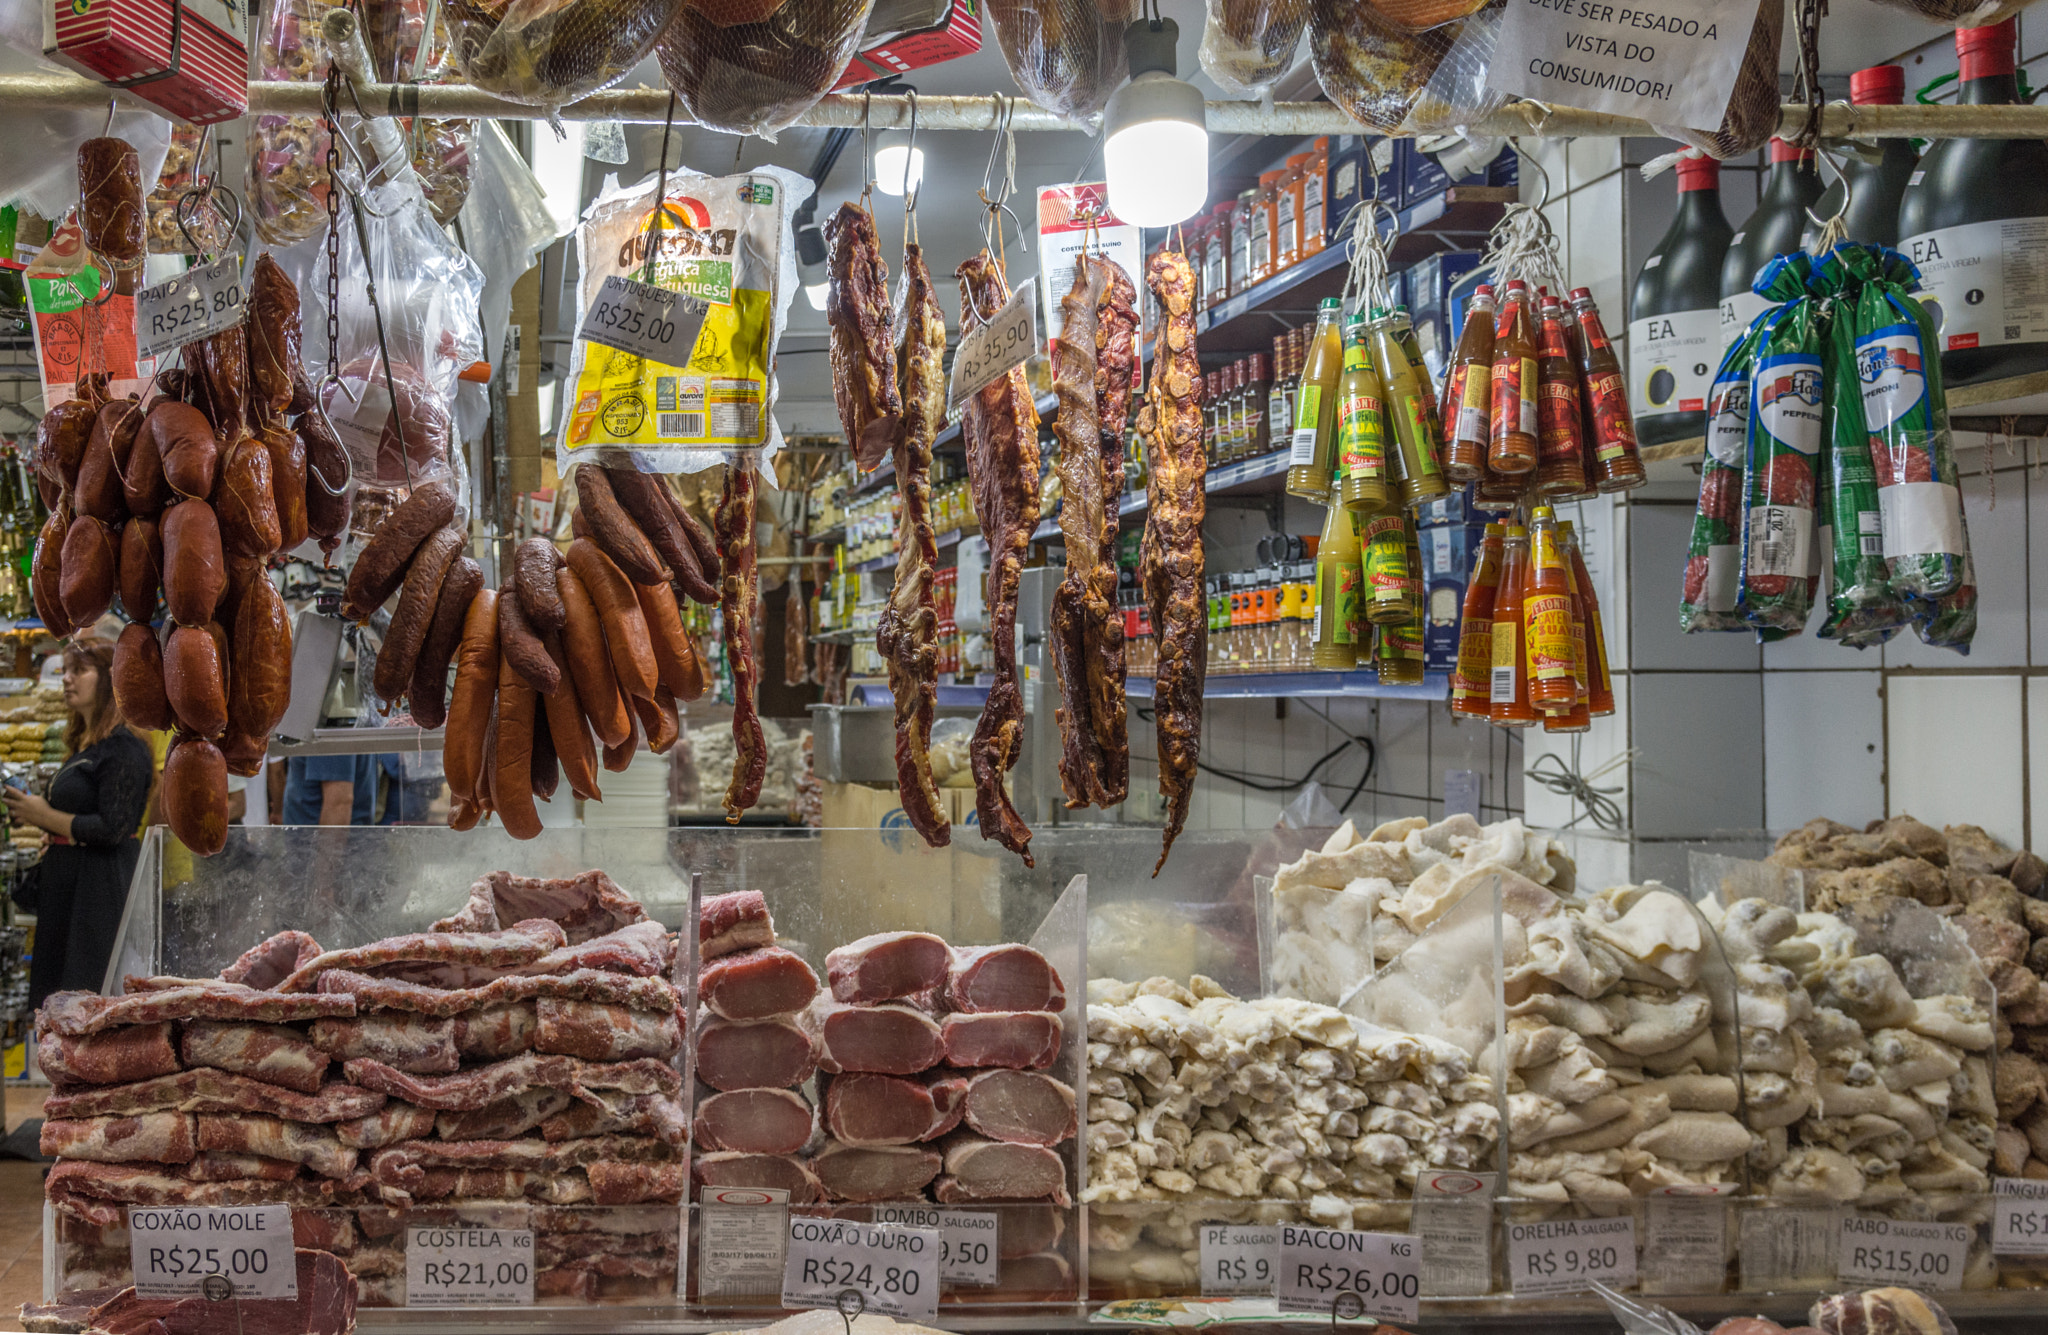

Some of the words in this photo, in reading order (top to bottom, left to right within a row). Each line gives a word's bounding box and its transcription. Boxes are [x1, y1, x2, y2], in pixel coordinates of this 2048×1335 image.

[1529, 0, 1572, 15] EVE
[1577, 2, 1614, 23] SER
[1618, 9, 1699, 37] PESADO
[1703, 24, 1718, 40] A
[1565, 31, 1618, 57] VISTA
[1624, 43, 1655, 63] DO
[1528, 58, 1673, 101] CONSUMIDOR!
[1912, 238, 1943, 265] EA
[140, 280, 179, 305] PAIO
[206, 267, 221, 281] KG
[607, 275, 677, 307] PORTUGUESA
[153, 285, 239, 336] R$25,80
[595, 302, 675, 344] R$25,00
[984, 319, 1029, 367] 35,90
[1648, 319, 1676, 341] EA
[132, 1208, 201, 1231] COXÃO
[208, 1213, 266, 1231] MOLE
[876, 1208, 940, 1226] LOMBO
[944, 1217, 995, 1230] SALGADO
[1512, 1222, 1578, 1240] ORELHA
[1581, 1222, 1629, 1235] SALGADA
[1843, 1217, 1889, 1236] RABO
[1892, 1226, 1940, 1241] SALGADO
[1944, 1226, 1967, 1242] KG
[417, 1230, 502, 1248] COSTELA
[513, 1236, 531, 1248] KG
[791, 1223, 860, 1247] COXÃO
[866, 1230, 924, 1254] DURO
[1208, 1227, 1228, 1246] PÉ
[1233, 1235, 1277, 1246] SALGAD
[1283, 1227, 1364, 1252] BACON
[1390, 1243, 1411, 1257] KG
[150, 1244, 268, 1278] R$25,00
[425, 1259, 528, 1289] R$21,00
[802, 1256, 920, 1296] R$24,80
[1217, 1256, 1247, 1283] R$
[1527, 1248, 1557, 1277] R$
[1564, 1246, 1617, 1274] 9,80
[1853, 1245, 1949, 1277] R$15,00
[1297, 1263, 1419, 1299] R$26,00
